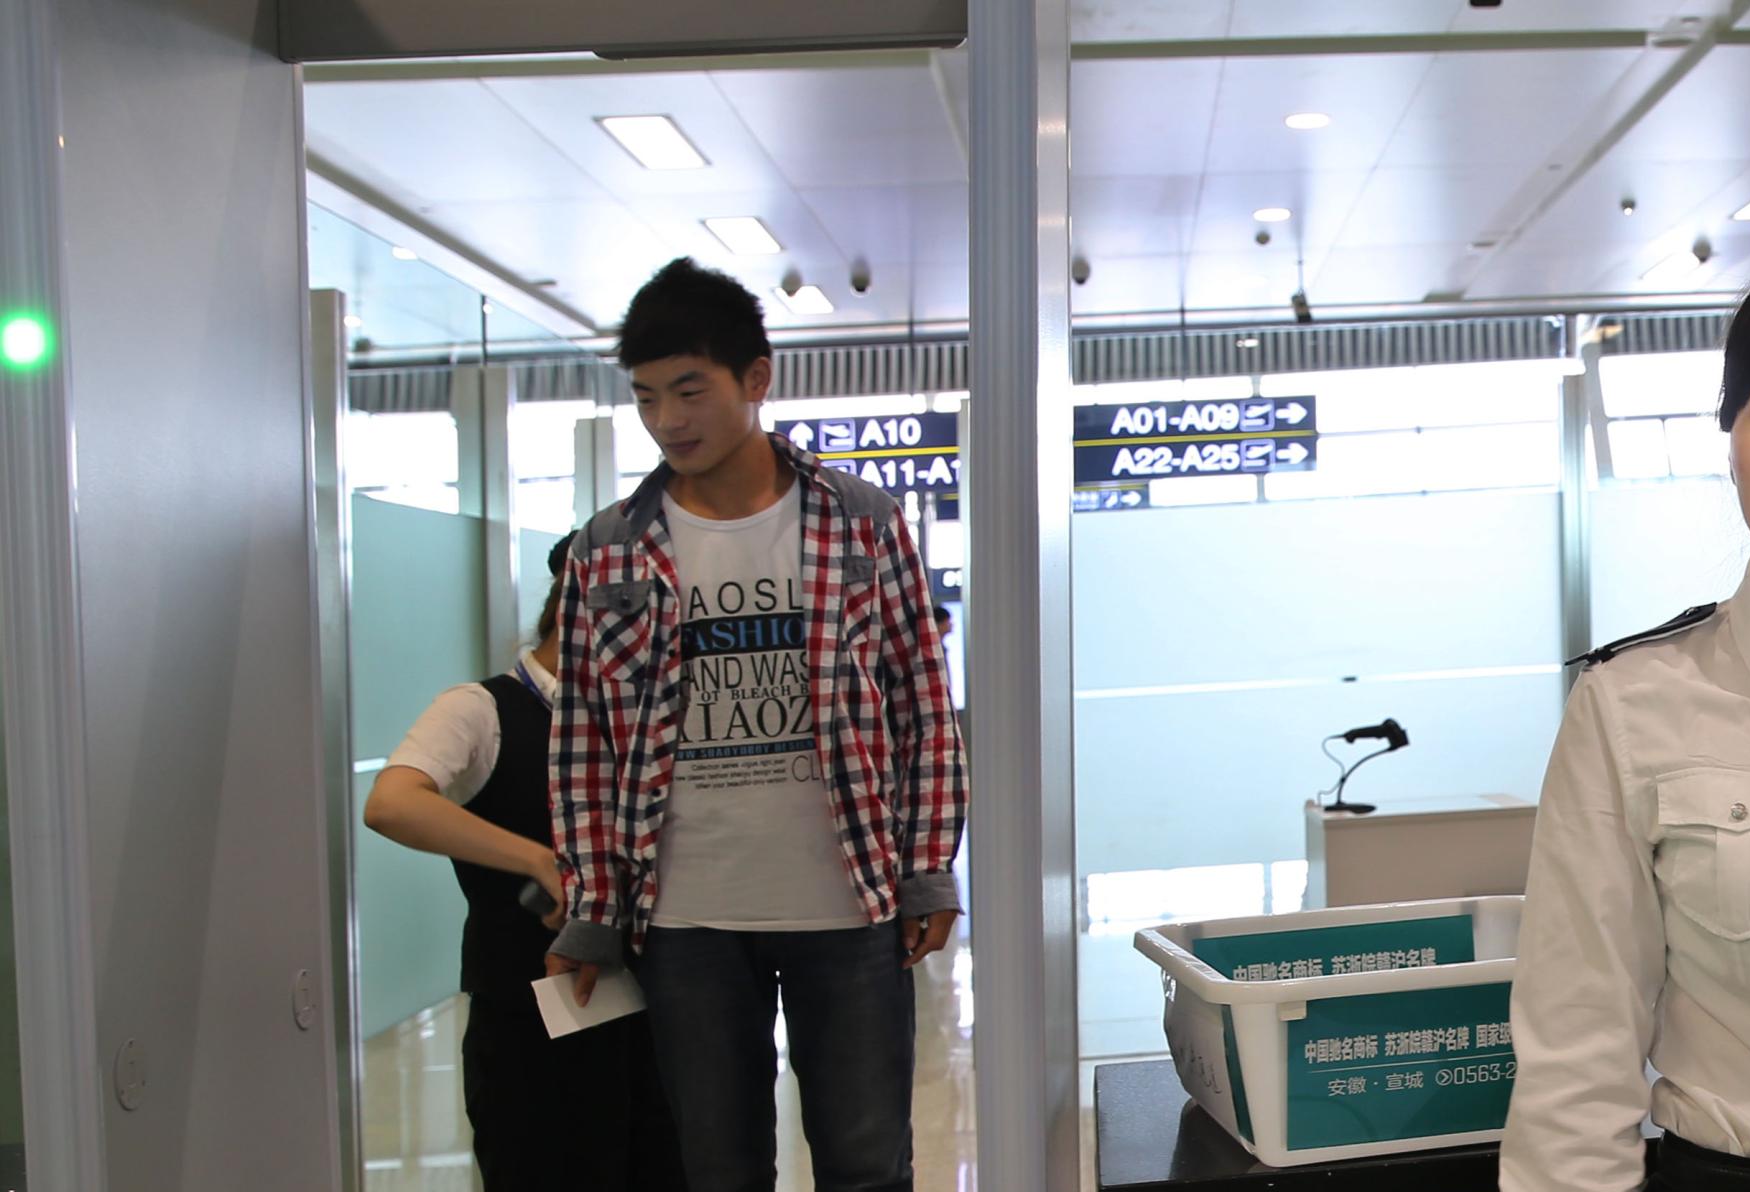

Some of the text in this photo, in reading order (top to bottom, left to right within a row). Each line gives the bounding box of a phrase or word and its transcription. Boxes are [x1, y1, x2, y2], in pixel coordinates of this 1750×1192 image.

[859, 417, 922, 448] A10
[1110, 402, 1240, 435] A01-A09
[1112, 443, 1241, 476] A22-A25
[731, 685, 791, 700] BLEACH
[1304, 1034, 1378, 1064] 中国驰名商标
